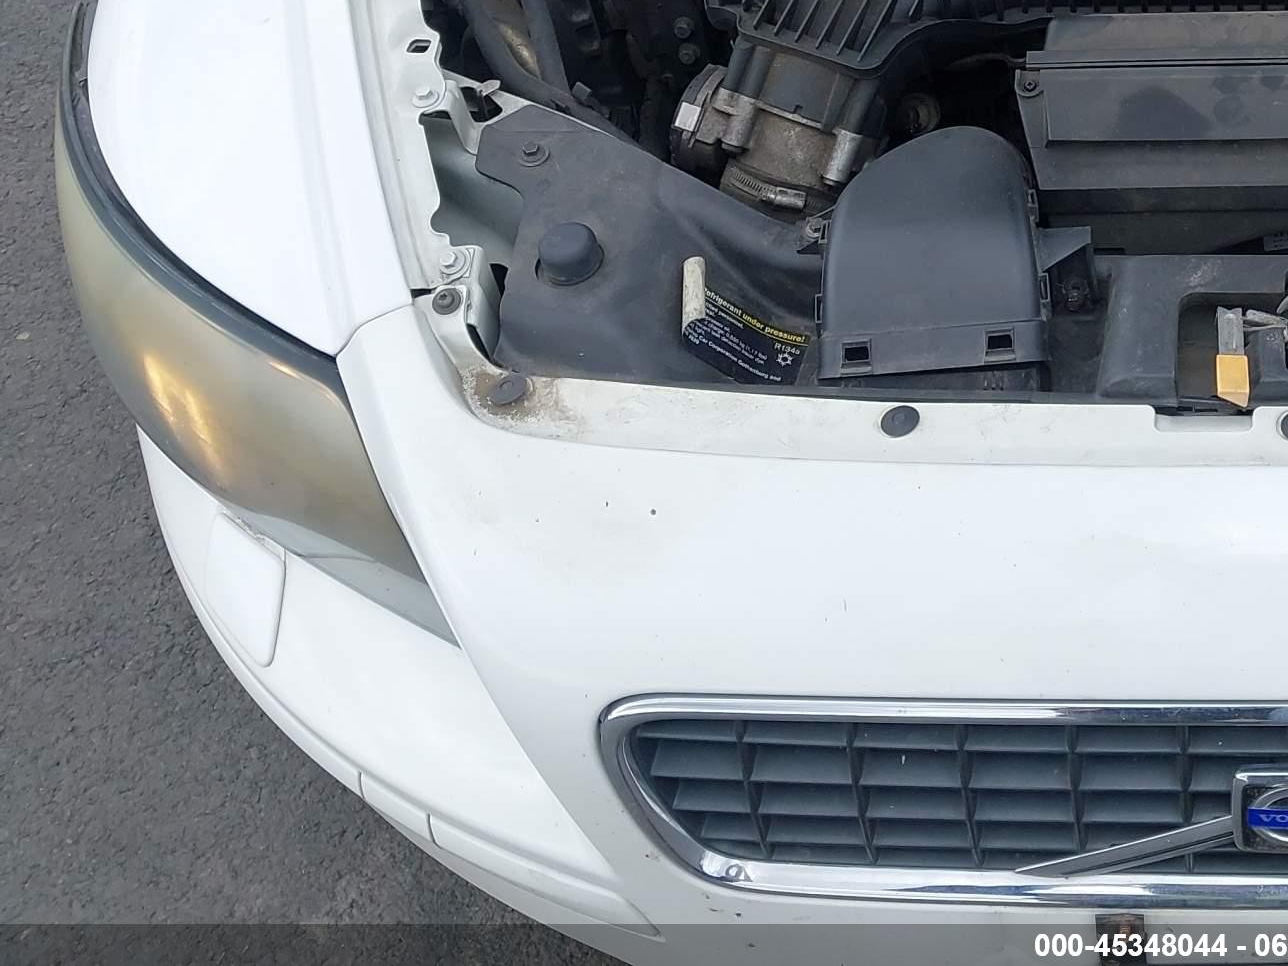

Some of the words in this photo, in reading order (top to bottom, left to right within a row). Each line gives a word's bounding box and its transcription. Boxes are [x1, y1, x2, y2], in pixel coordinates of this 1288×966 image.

[742, 313, 764, 330] under
[764, 325, 806, 343] pressure!
[774, 342, 801, 355] R134a
